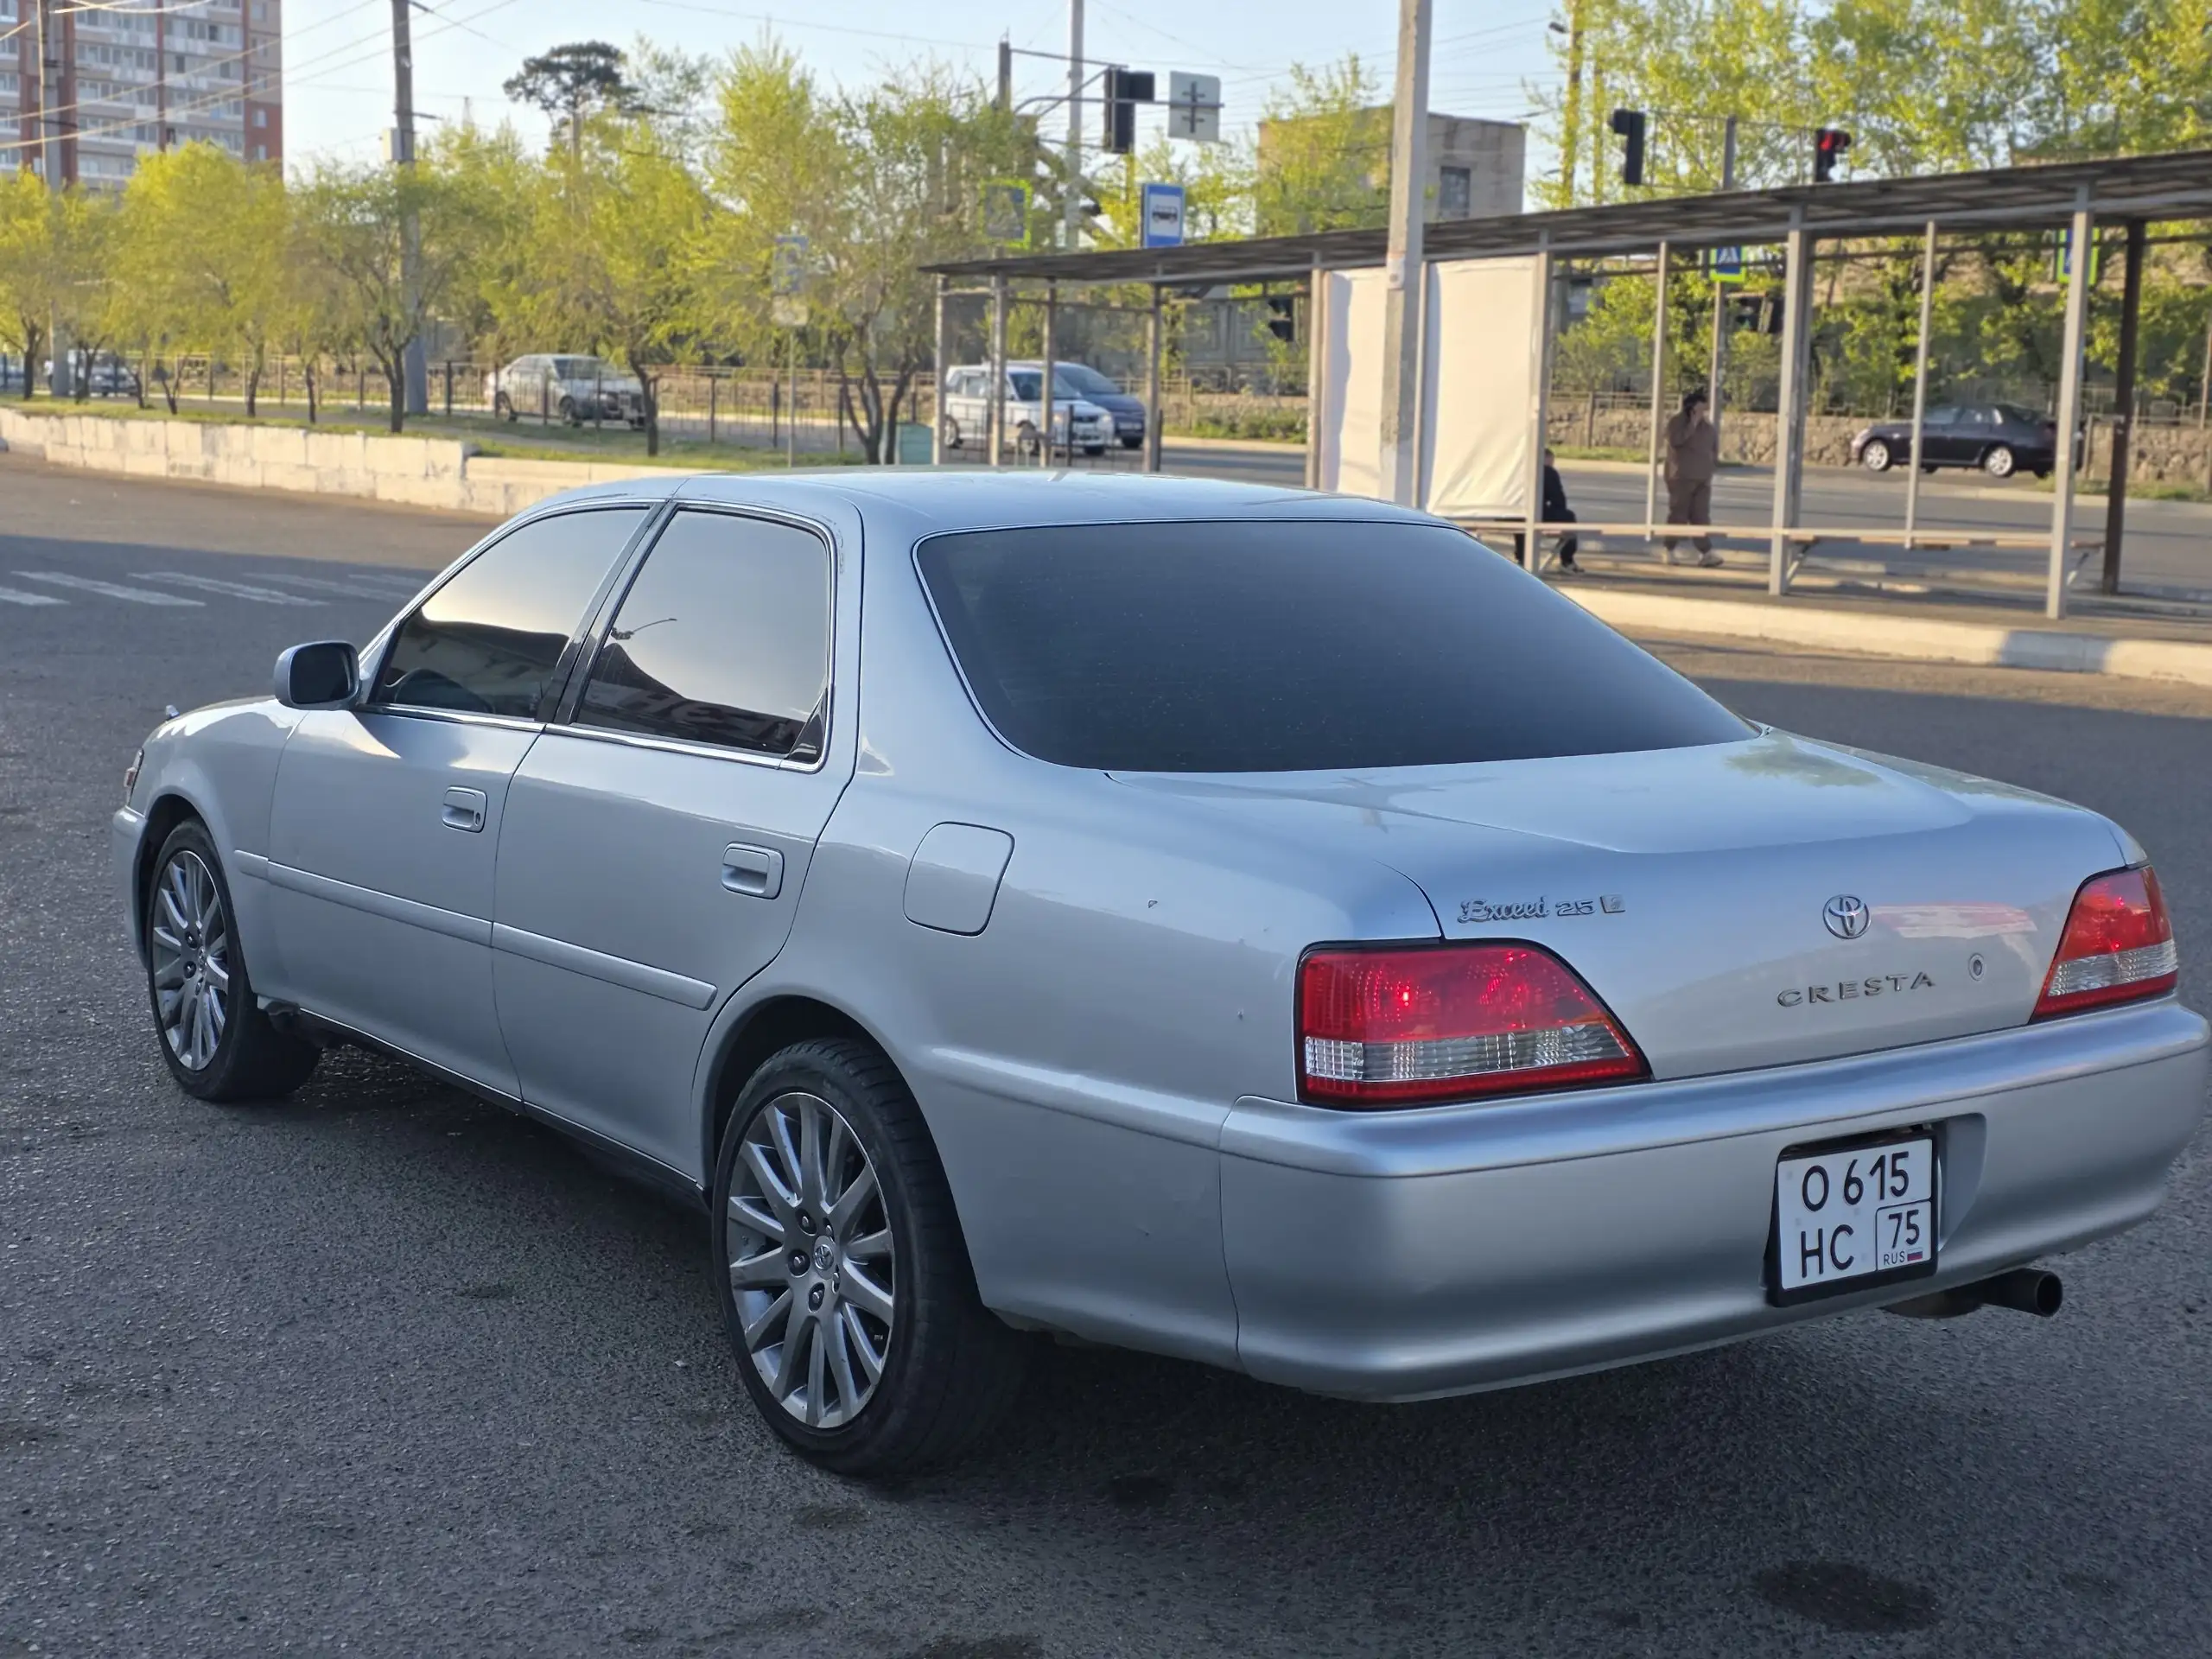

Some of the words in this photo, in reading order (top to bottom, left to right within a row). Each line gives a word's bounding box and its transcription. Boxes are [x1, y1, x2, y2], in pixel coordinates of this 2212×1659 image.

[1457, 895, 1550, 924] Exceed
[1777, 971, 1936, 1007] CRESTA
[1843, 1151, 1910, 1205] 615
[1888, 1209, 1920, 1249] 75
[1801, 1224, 1854, 1279] НС
[1884, 1250, 1905, 1266] RUS
